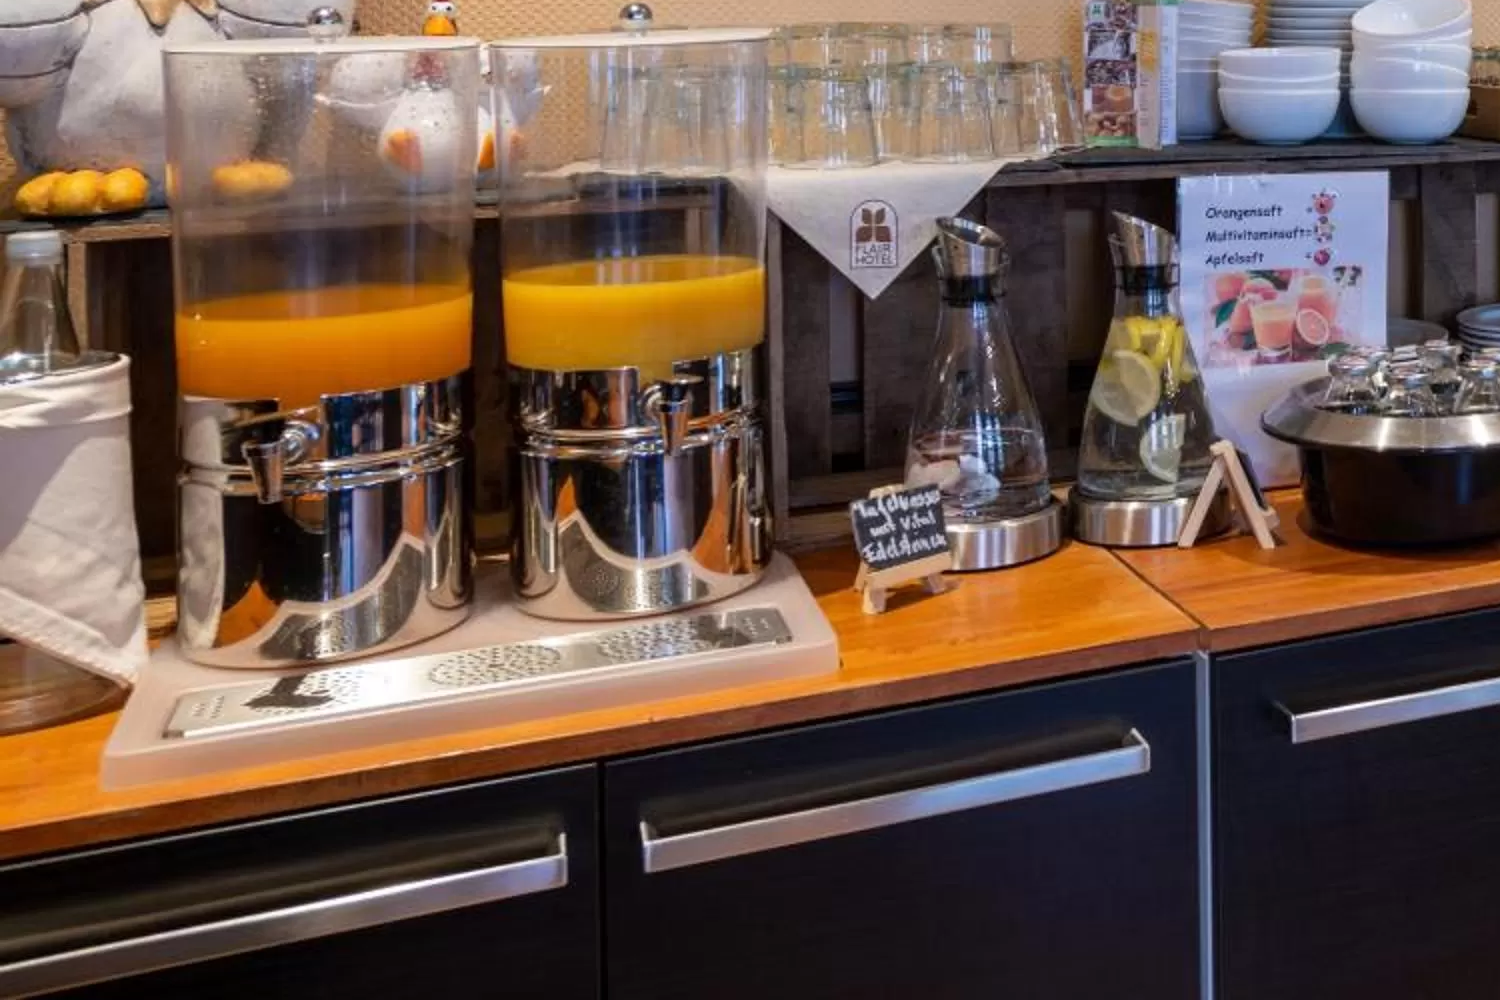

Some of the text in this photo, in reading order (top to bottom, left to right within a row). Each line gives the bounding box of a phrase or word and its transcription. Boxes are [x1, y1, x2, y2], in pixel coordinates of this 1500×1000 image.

[1205, 205, 1282, 220] Orangensaft
[856, 243, 891, 254] FLAIR
[856, 255, 893, 265] HOTEL
[1205, 251, 1264, 268] Apfelsaft
[900, 510, 937, 531] Vital
